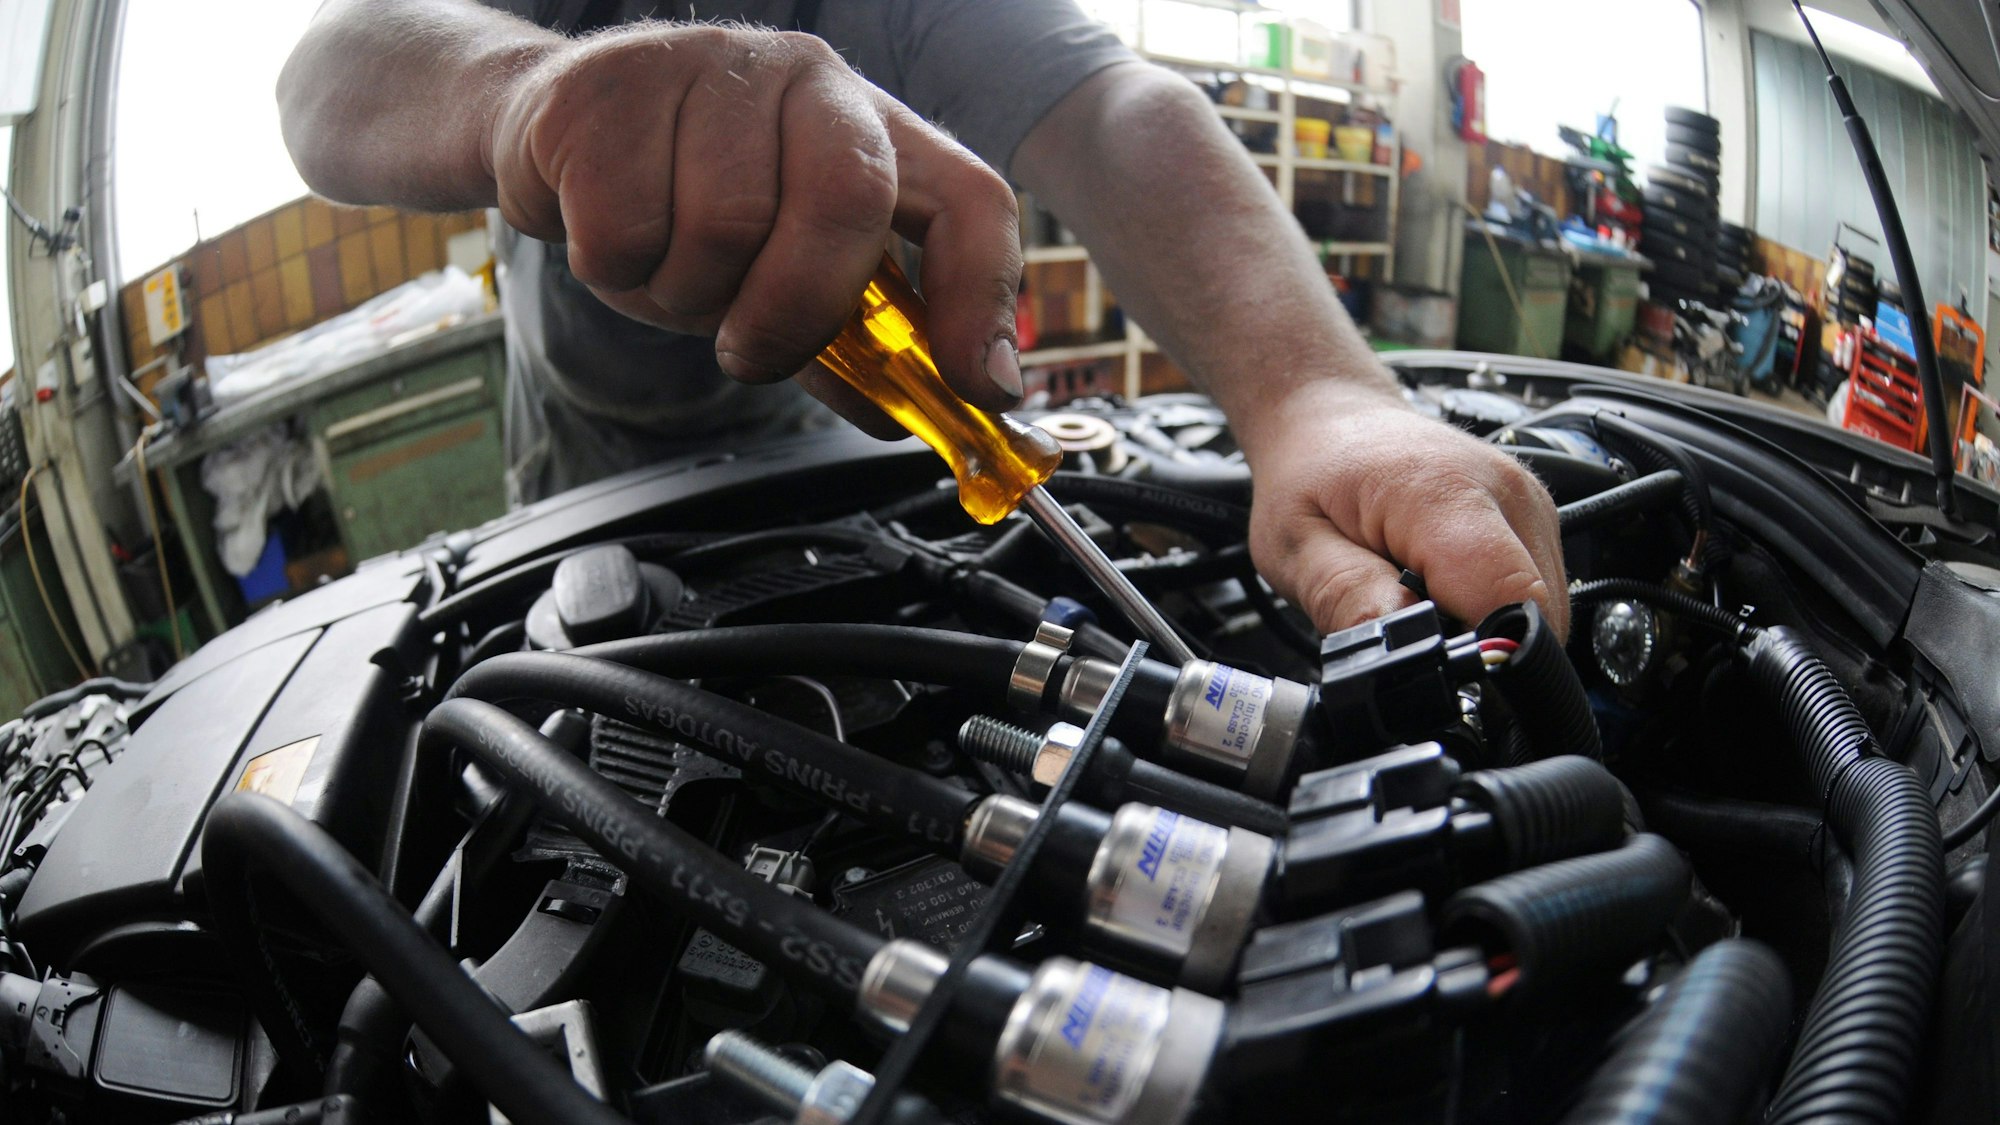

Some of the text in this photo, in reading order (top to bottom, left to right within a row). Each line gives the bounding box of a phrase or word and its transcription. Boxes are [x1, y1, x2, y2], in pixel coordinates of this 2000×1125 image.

[1087, 480, 1137, 497] PRINS
[1141, 489, 1230, 519] AUTOGAS
[625, 695, 761, 762] AUTOGAS
[1223, 737, 1232, 747] 2
[1227, 698, 1245, 734] CLASS
[1235, 702, 1257, 752] injector
[478, 725, 562, 798] AUTOGAS
[764, 750, 871, 813] PRINS
[562, 788, 645, 861] PRINS
[672, 862, 749, 928] 5x11
[922, 904, 965, 926] GERMANY
